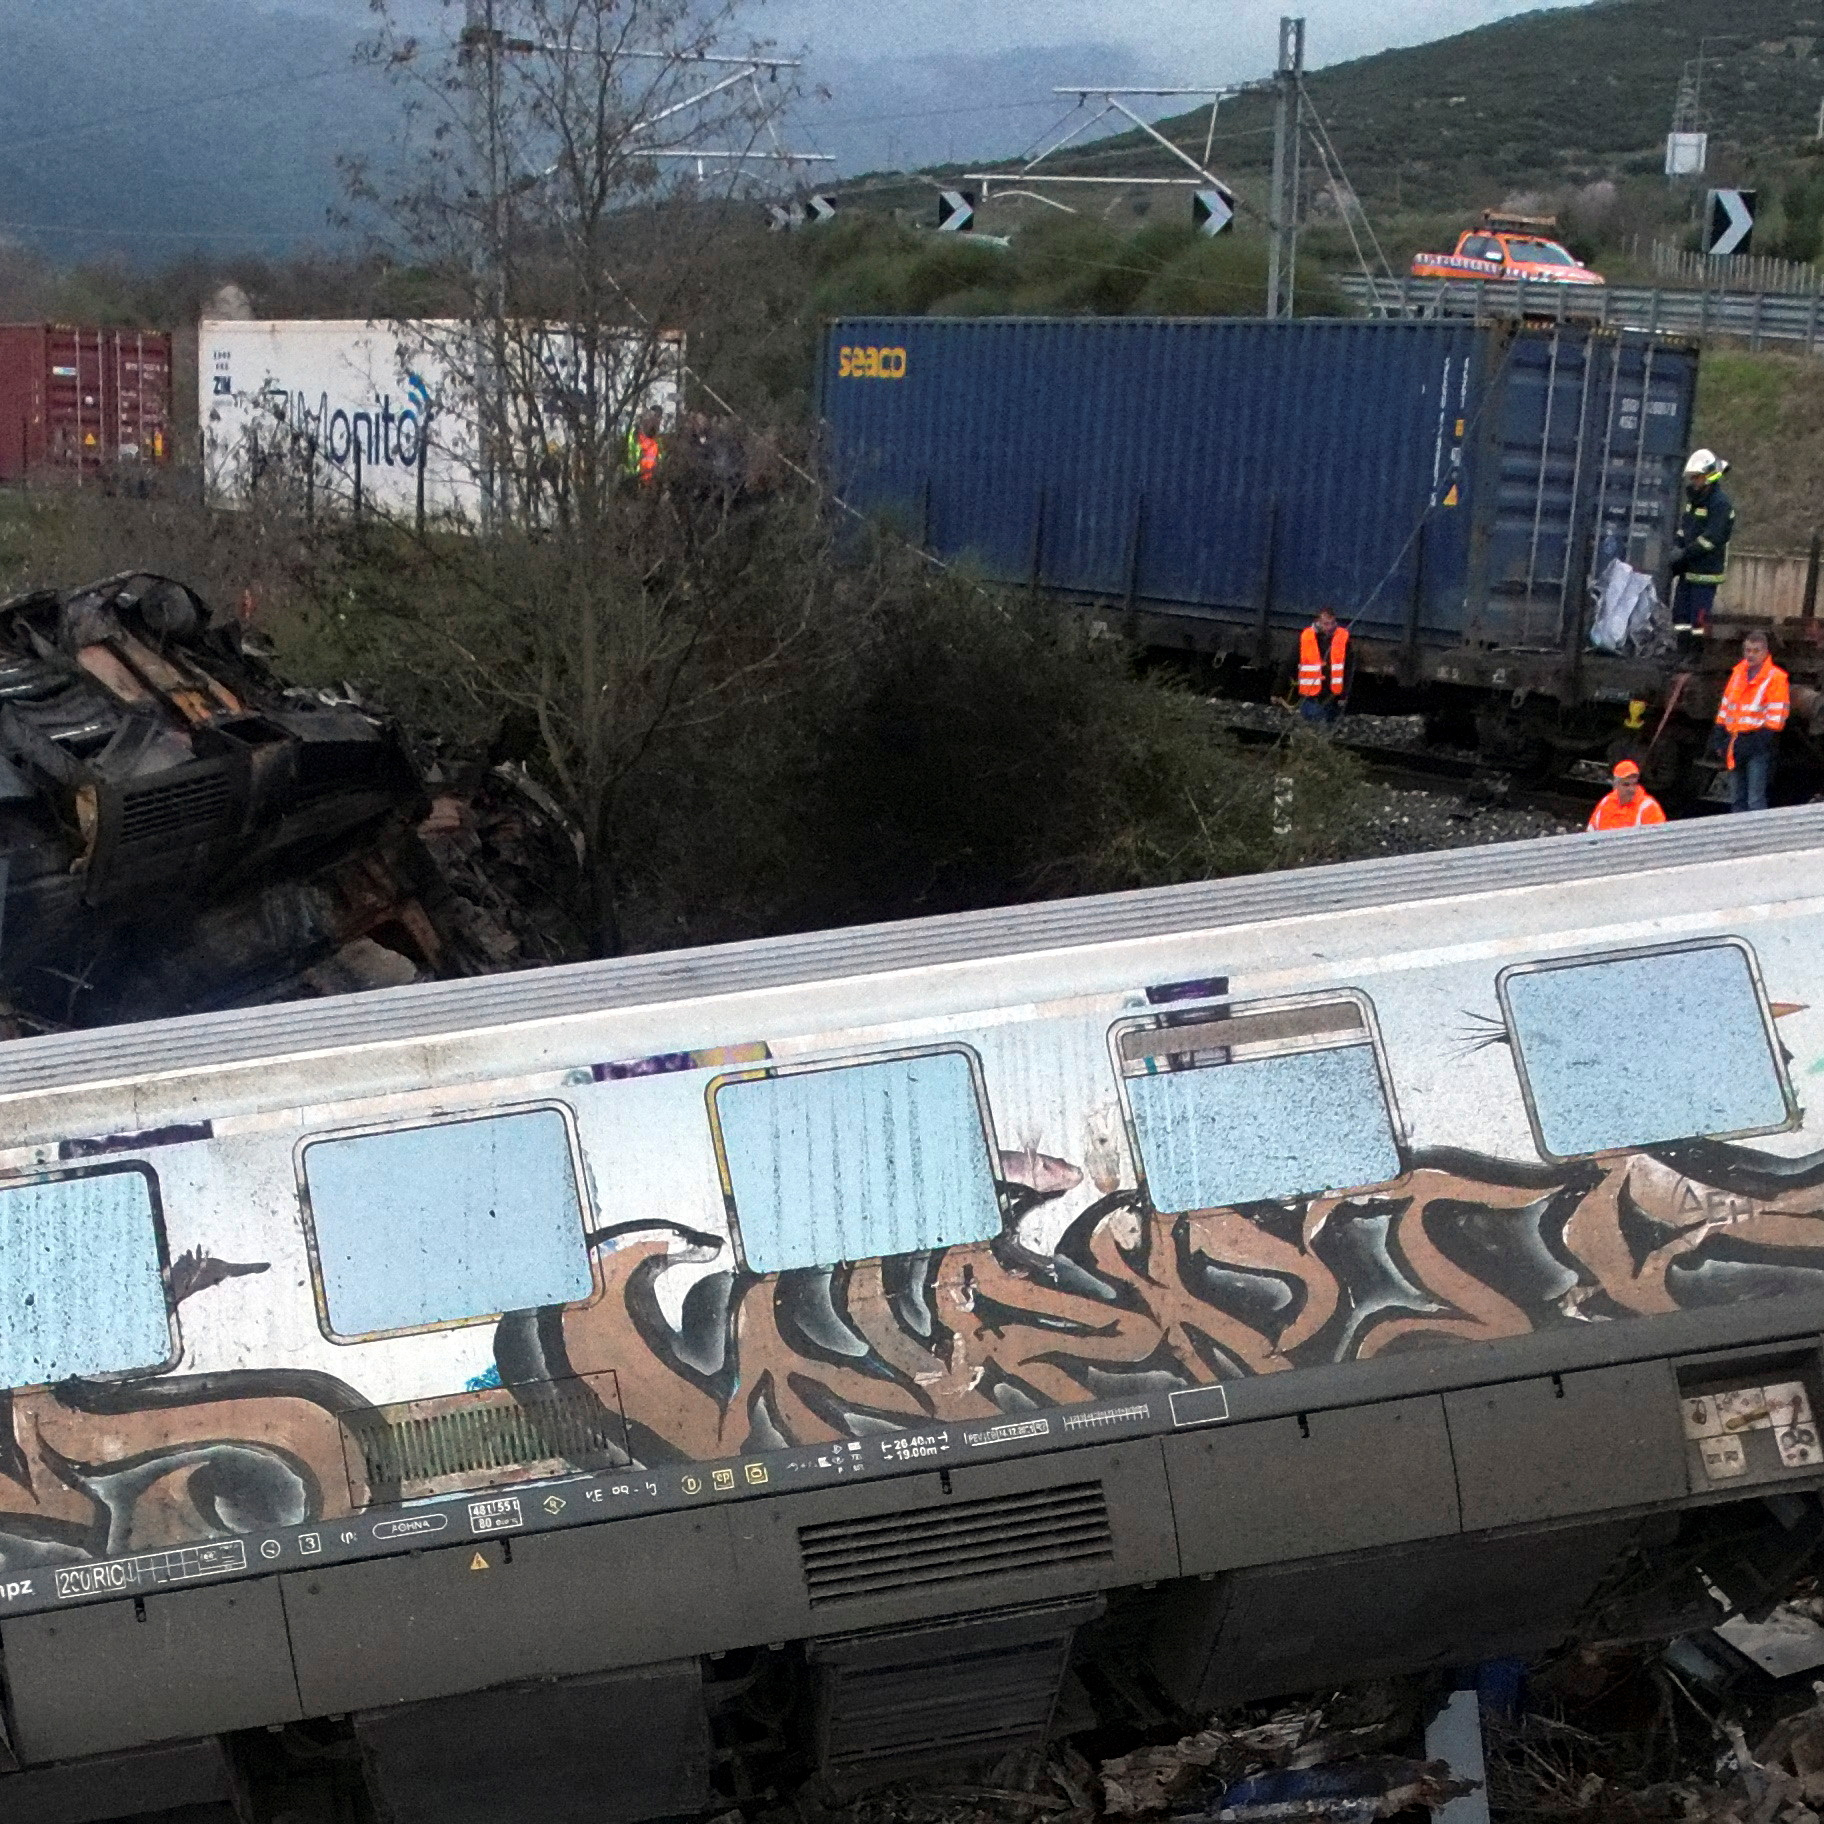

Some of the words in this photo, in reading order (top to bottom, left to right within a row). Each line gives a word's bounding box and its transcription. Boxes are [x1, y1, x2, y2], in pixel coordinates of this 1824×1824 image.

[838, 346, 907, 378] seaco
[896, 1446, 938, 1461] 19.00m
[479, 1517, 492, 1529] 80
